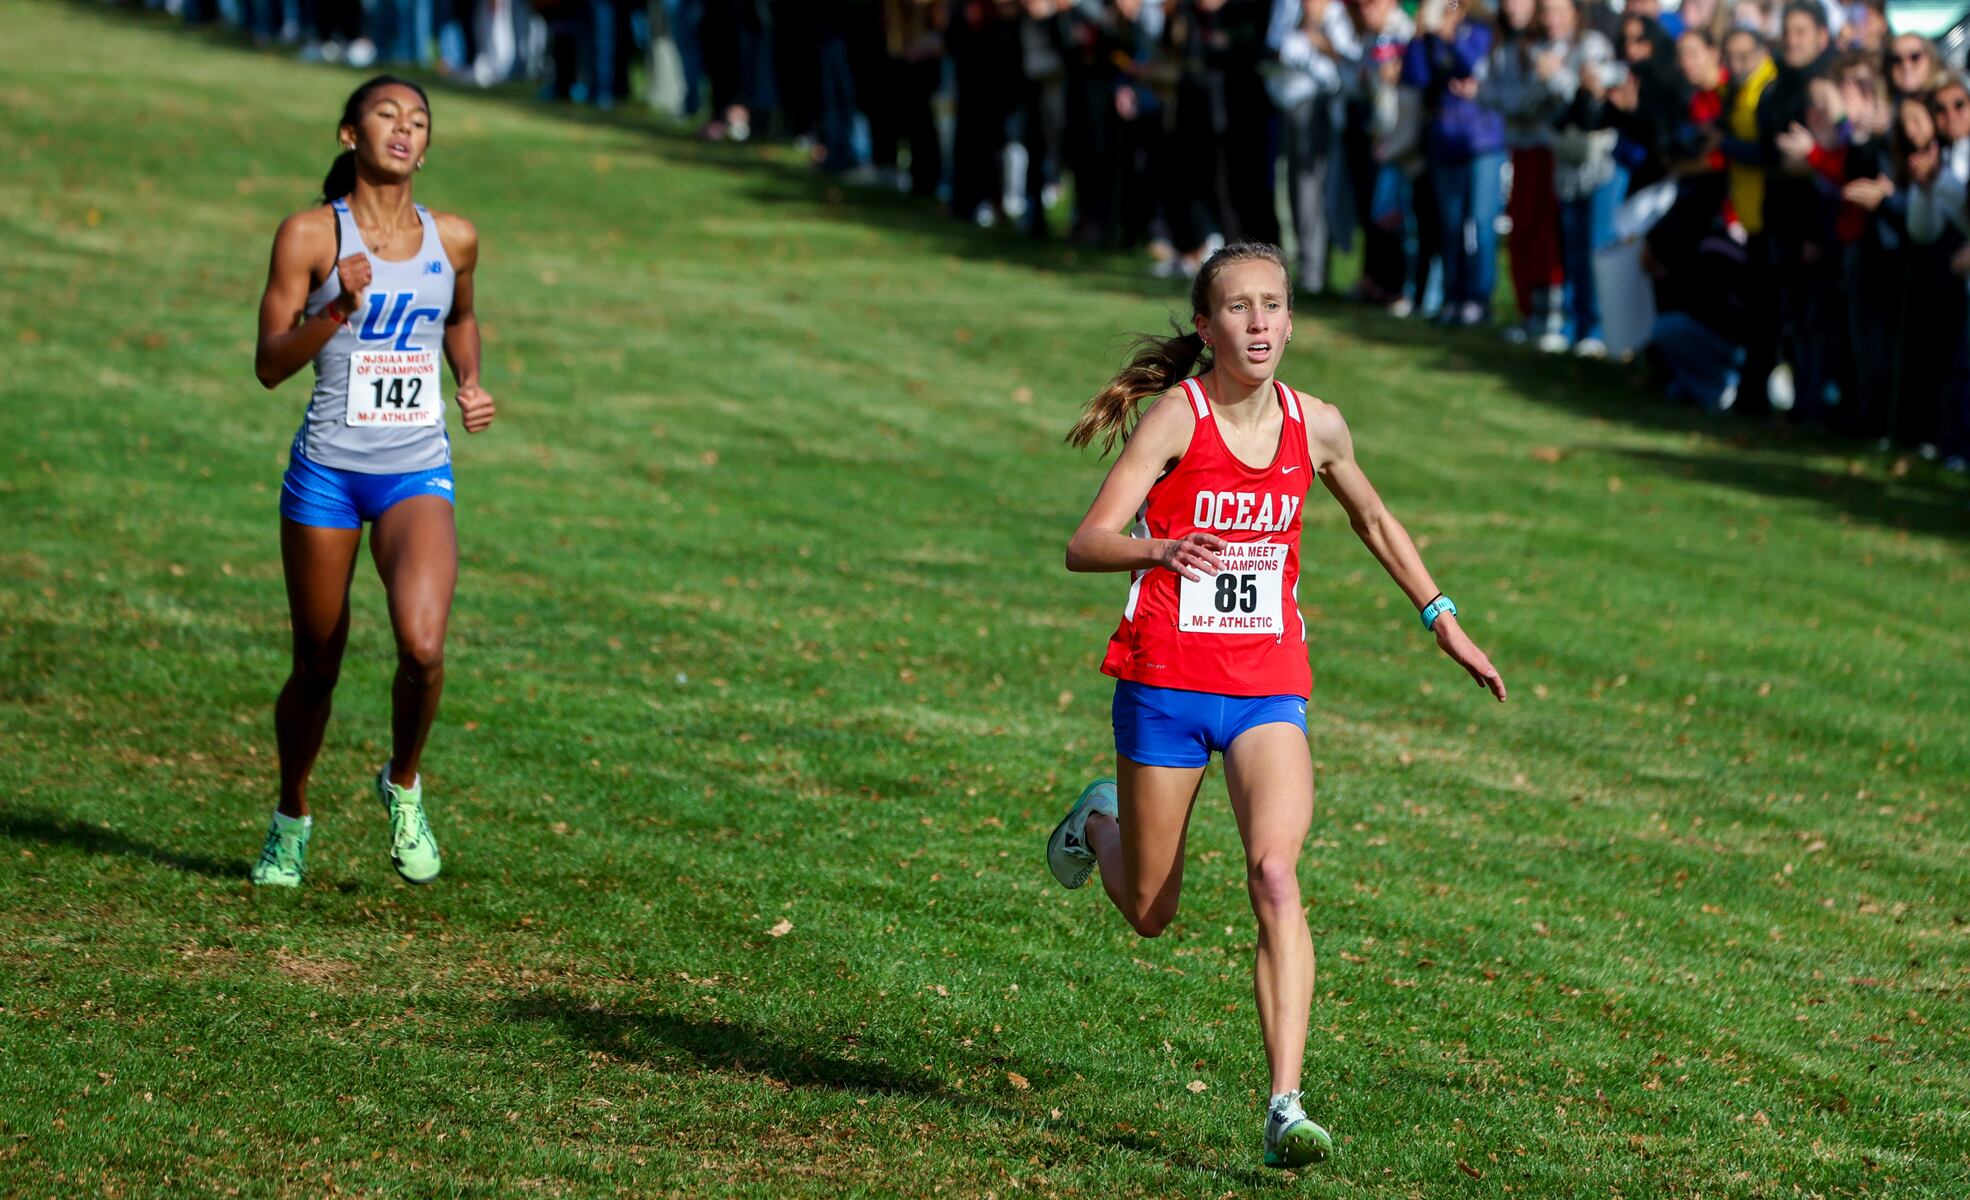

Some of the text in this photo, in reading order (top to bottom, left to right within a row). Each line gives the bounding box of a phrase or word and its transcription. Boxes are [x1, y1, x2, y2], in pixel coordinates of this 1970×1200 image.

[359, 293, 441, 351] UC
[363, 353, 432, 363] NJSIAA MEET
[357, 363, 434, 375] OF CHAMPIONS
[371, 378, 422, 408] 142
[358, 411, 430, 422] M-F ATHLETIC
[1194, 491, 1299, 531] OCEAN
[1247, 546, 1277, 557] MEET
[1221, 559, 1279, 572] HAMPIONS
[1214, 573, 1258, 613] 85
[1192, 615, 1273, 629] M-F ATHLETIC
